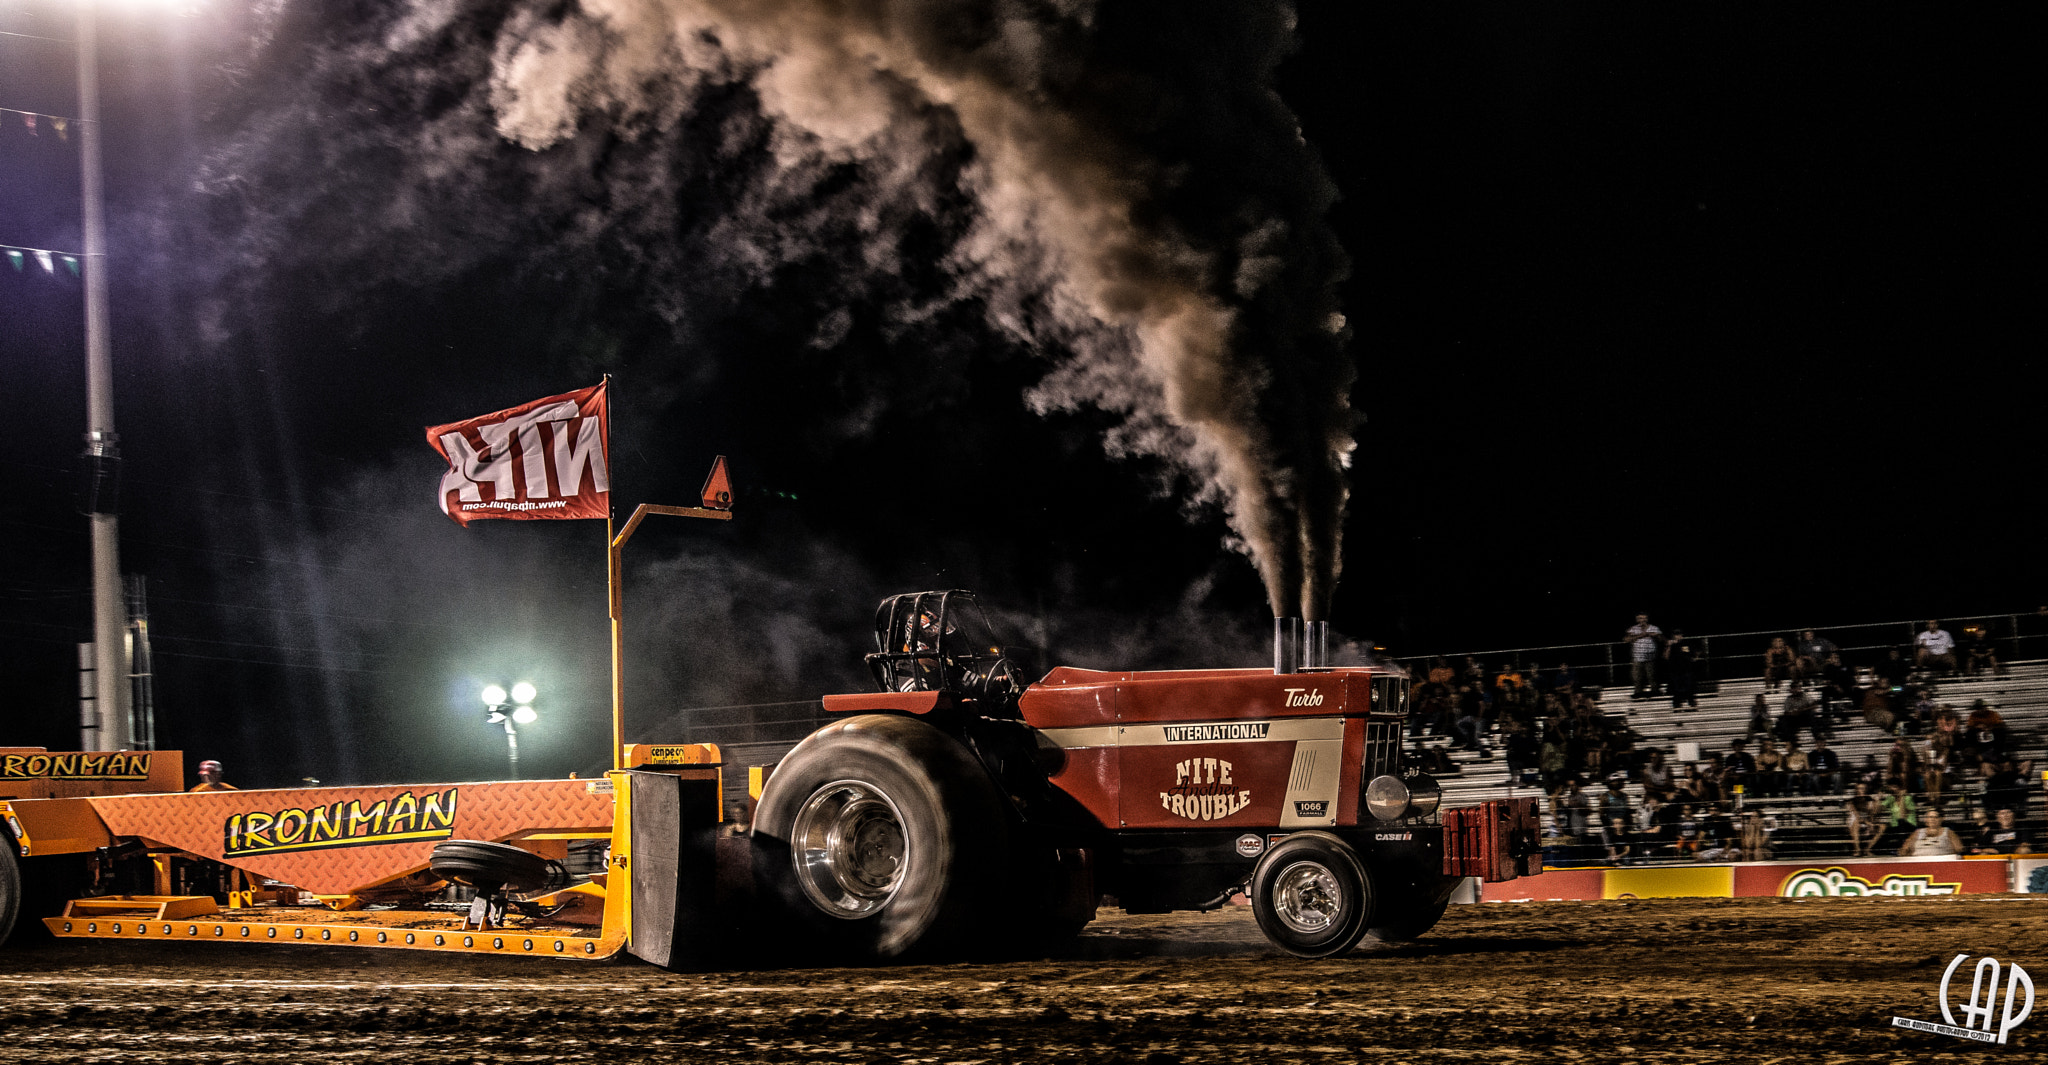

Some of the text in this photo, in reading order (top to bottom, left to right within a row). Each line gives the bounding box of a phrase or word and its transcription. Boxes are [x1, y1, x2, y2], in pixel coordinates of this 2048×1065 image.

[1283, 687, 1325, 708] Turbo
[1166, 724, 1267, 742] INTERNATIONAL
[0, 753, 152, 778] RONMAN
[1175, 757, 1233, 786] NITE
[1167, 775, 1239, 797] Another
[1160, 790, 1251, 821] TROUBLE
[1301, 802, 1322, 811] 1066
[224, 788, 458, 856] IRONMAN
